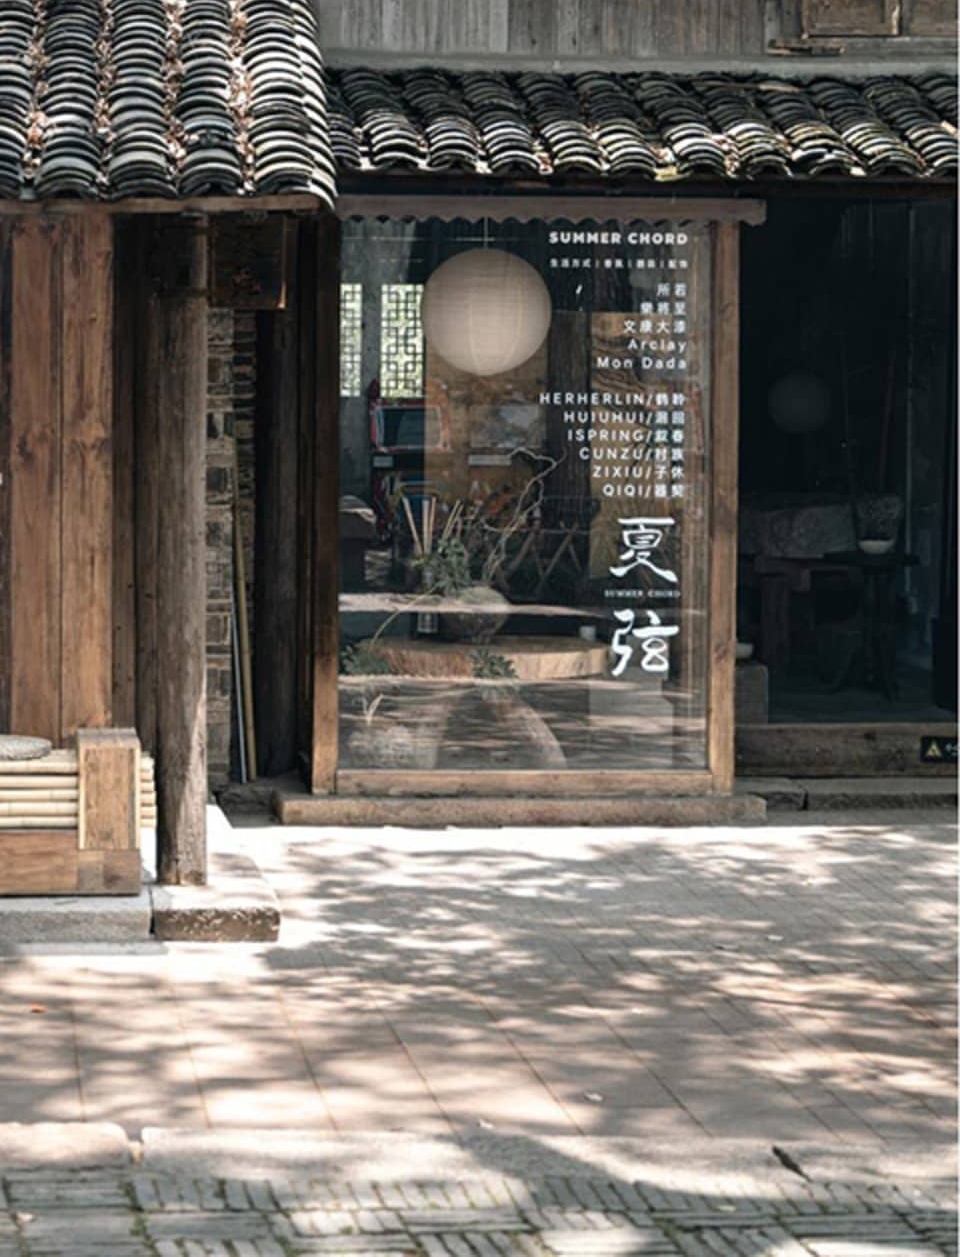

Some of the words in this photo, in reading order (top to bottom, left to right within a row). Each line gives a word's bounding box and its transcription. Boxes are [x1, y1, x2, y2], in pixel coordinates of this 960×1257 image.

[549, 231, 622, 244] SUMMER
[628, 232, 688, 244] CHORD
[627, 339, 687, 352] Arclay
[596, 357, 634, 370] Mon
[642, 356, 687, 370] Dada
